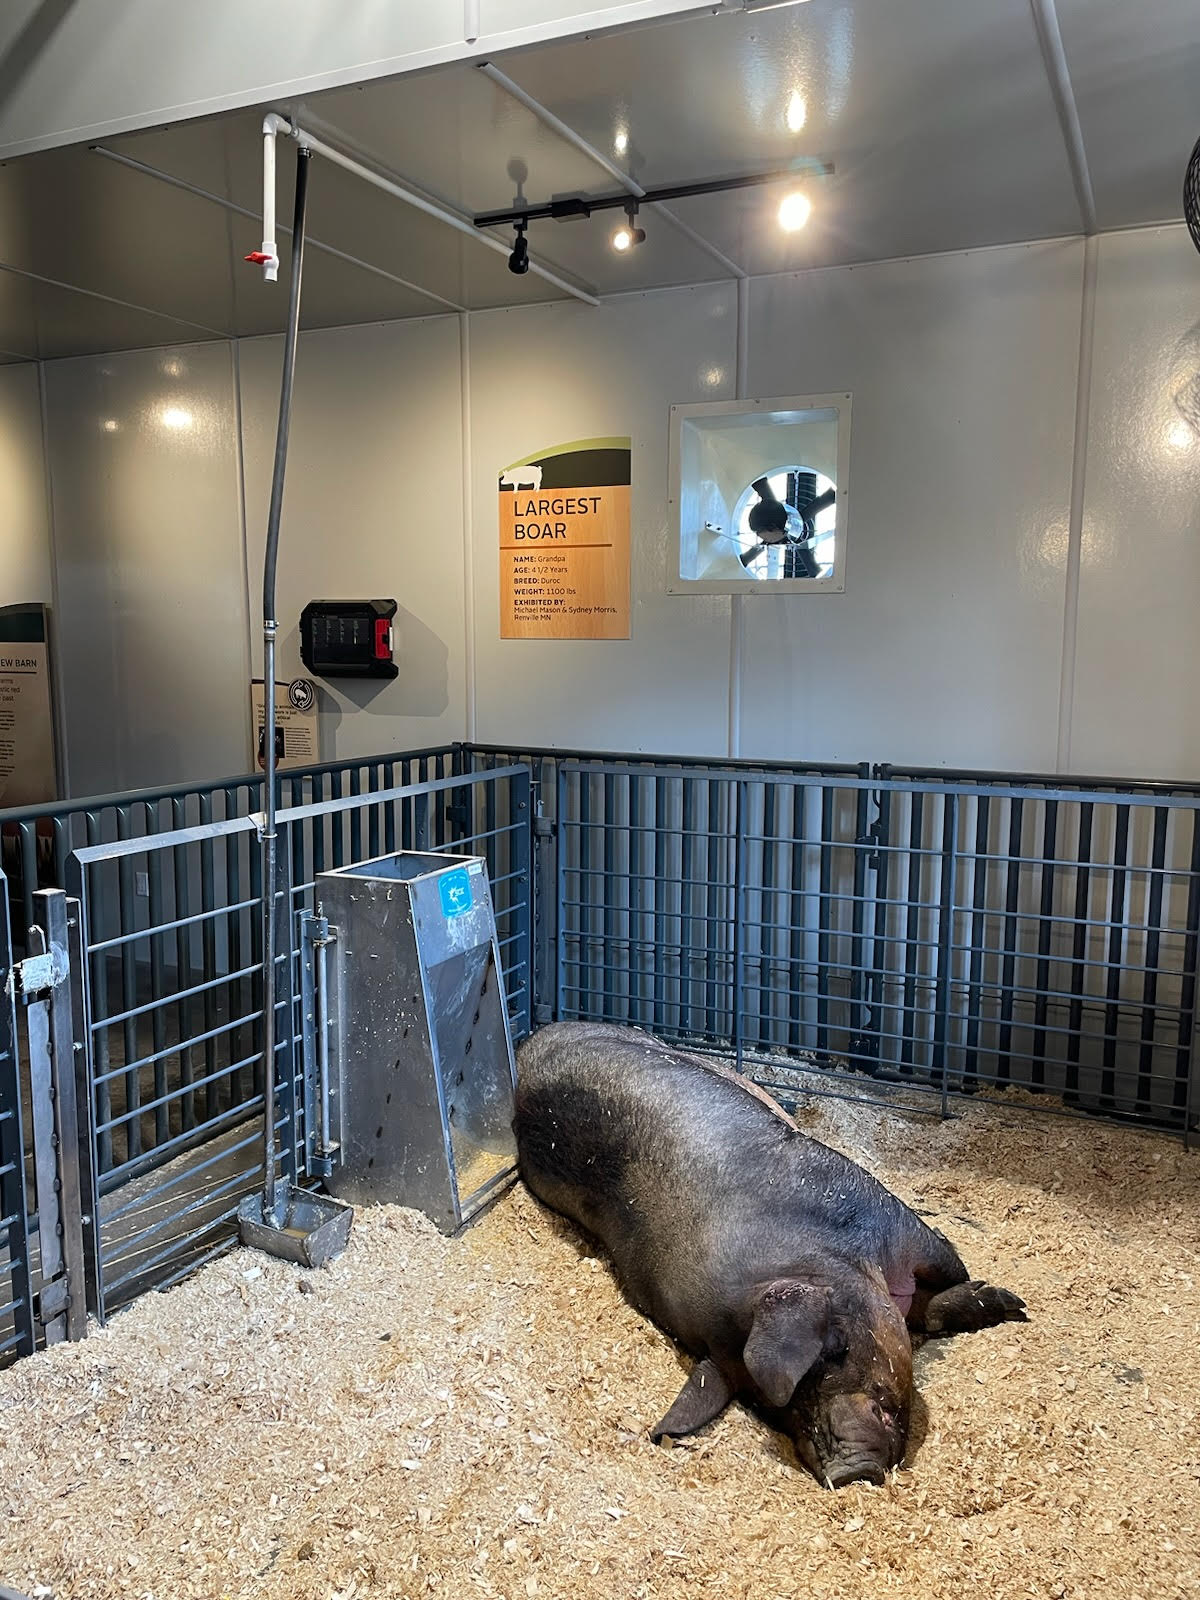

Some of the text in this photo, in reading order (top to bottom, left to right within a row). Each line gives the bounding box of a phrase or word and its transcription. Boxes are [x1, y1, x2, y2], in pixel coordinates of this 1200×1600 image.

[514, 497, 602, 517] LARGEST
[514, 522, 567, 540] BOAR
[537, 555, 566, 563] Grandpa
[513, 566, 530, 574] AGE:
[513, 577, 561, 585] BREED: Duroc
[513, 588, 545, 596] WEIGHT:
[566, 587, 577, 595] lbs
[514, 606, 539, 614] Michael
[539, 606, 561, 614] Mason
[568, 606, 593, 615] Sydney
[593, 606, 618, 614] Morris,
[15, 659, 37, 668] BARN
